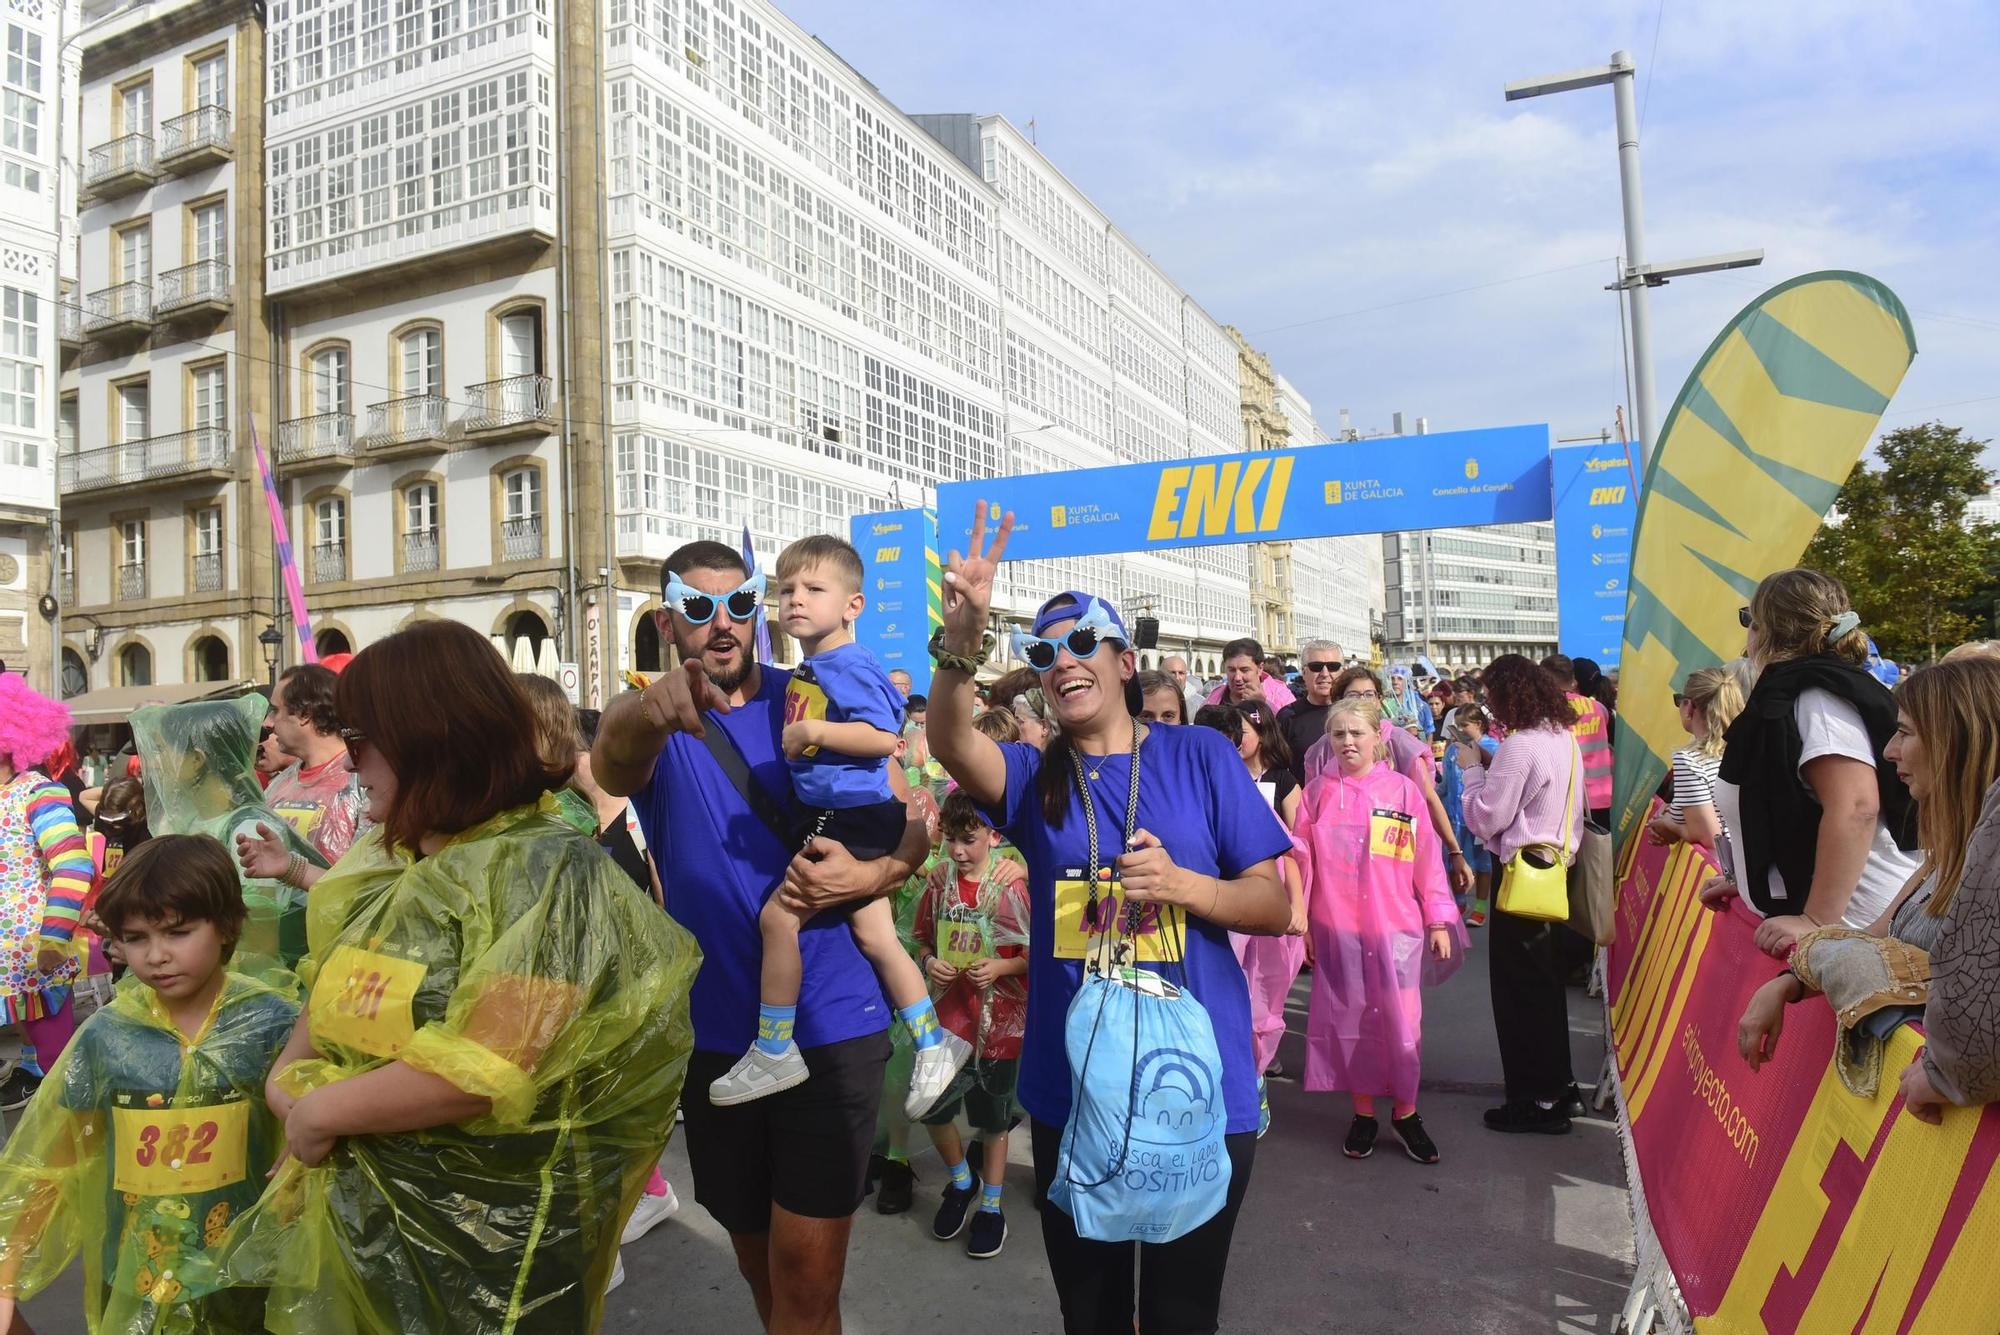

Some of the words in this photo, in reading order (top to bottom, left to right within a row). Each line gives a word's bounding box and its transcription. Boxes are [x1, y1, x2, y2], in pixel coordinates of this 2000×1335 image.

[1344, 479, 1380, 490] XUNTA
[1432, 486, 1468, 497] Concello
[1469, 485, 1481, 494] da
[1146, 456, 1295, 541] ENKI
[1344, 491, 1359, 501] DE
[1361, 487, 1404, 499] GALICIA
[1589, 486, 1626, 506] ENKI
[1068, 504, 1100, 515] XUNTA
[1068, 516, 1082, 525] DE
[1083, 512, 1120, 524] GALICIA
[875, 547, 901, 563] ENKI
[785, 689, 810, 726] 51
[948, 930, 981, 954] 285
[1682, 1023, 1759, 1169] enkiproyecto.com
[136, 1121, 219, 1168] 382
